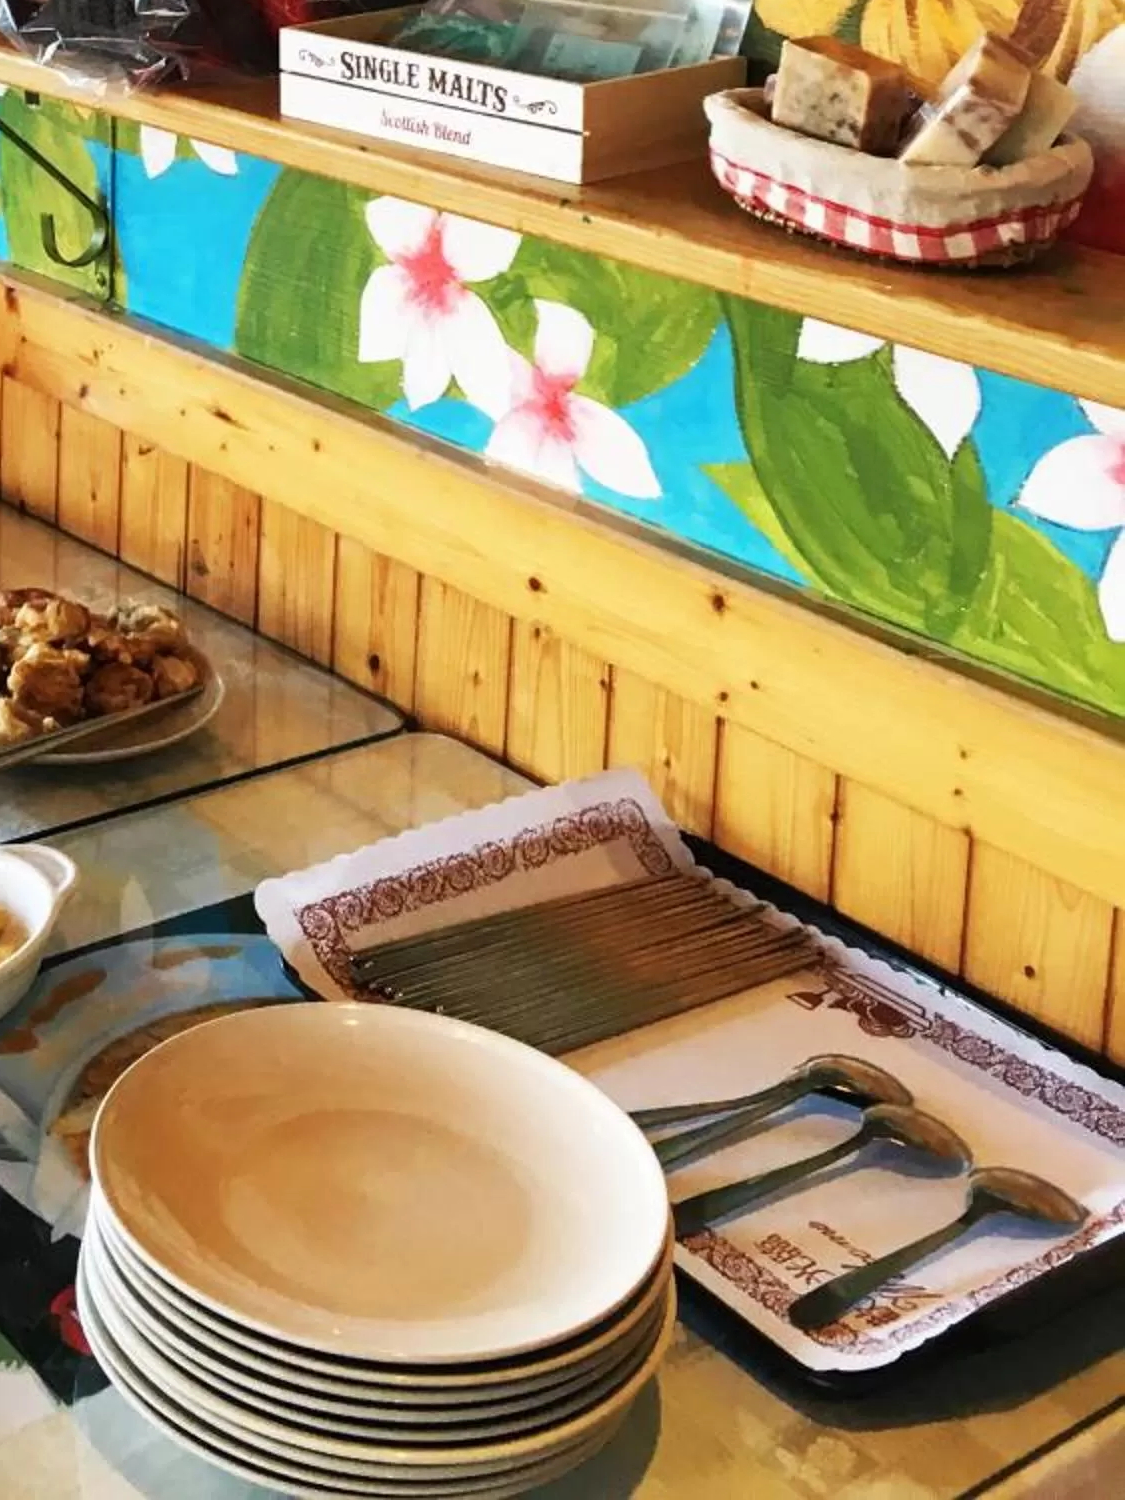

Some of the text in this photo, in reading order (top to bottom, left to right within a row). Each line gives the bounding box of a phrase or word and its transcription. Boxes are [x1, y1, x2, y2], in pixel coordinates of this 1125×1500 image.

[340, 51, 508, 113] SINGLE MALTS
[381, 108, 472, 145] Scottish Blend
